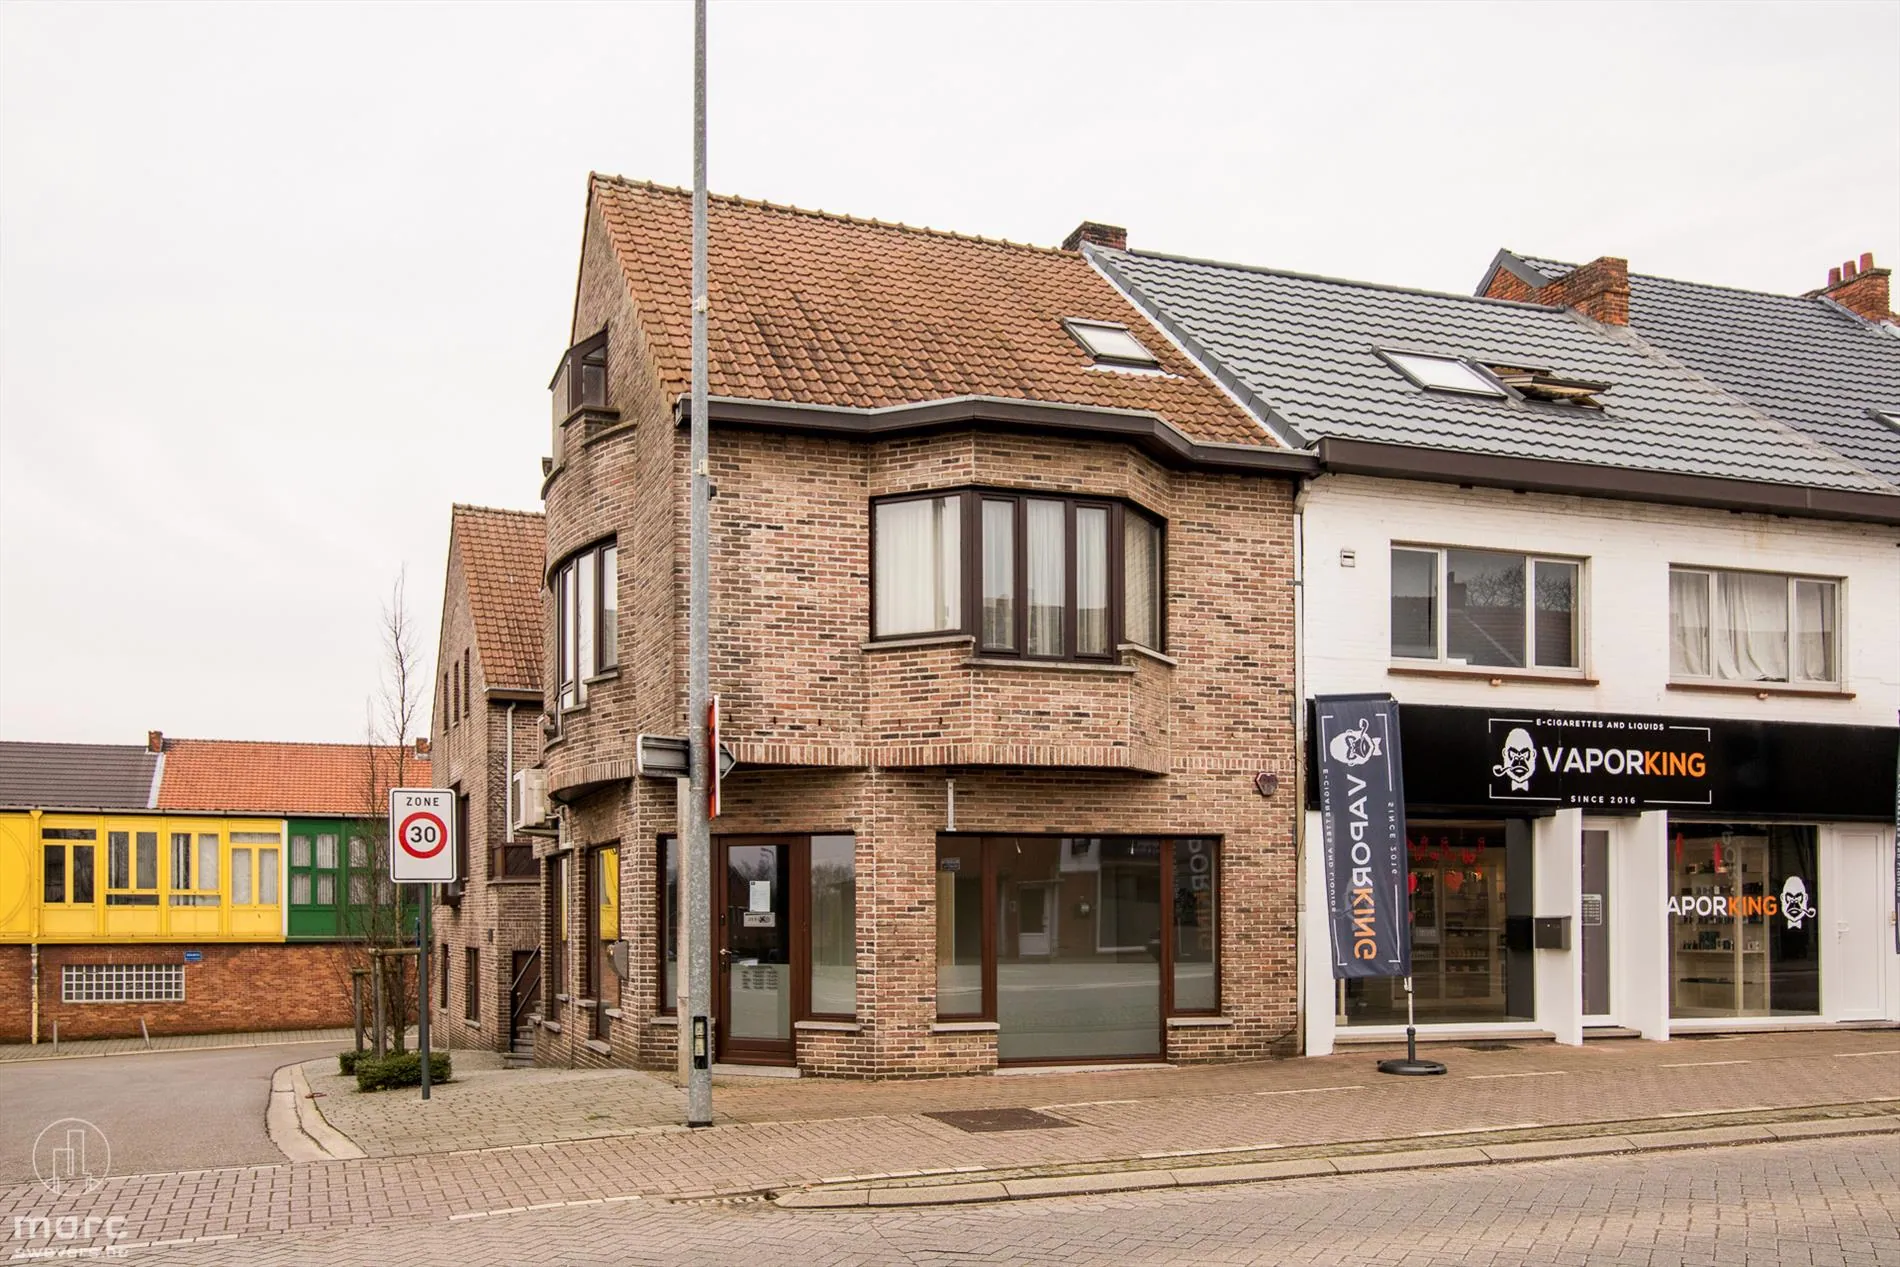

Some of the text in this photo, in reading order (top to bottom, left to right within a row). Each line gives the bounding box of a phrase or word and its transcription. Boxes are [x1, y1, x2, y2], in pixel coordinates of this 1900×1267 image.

[1535, 718, 1665, 731] E-CIGARETTES AND LIQUIDS
[1542, 746, 1707, 778] VAPORKING
[406, 796, 440, 807] ZONE
[1570, 795, 1636, 805] SINCE 2016
[410, 826, 436, 843] 30
